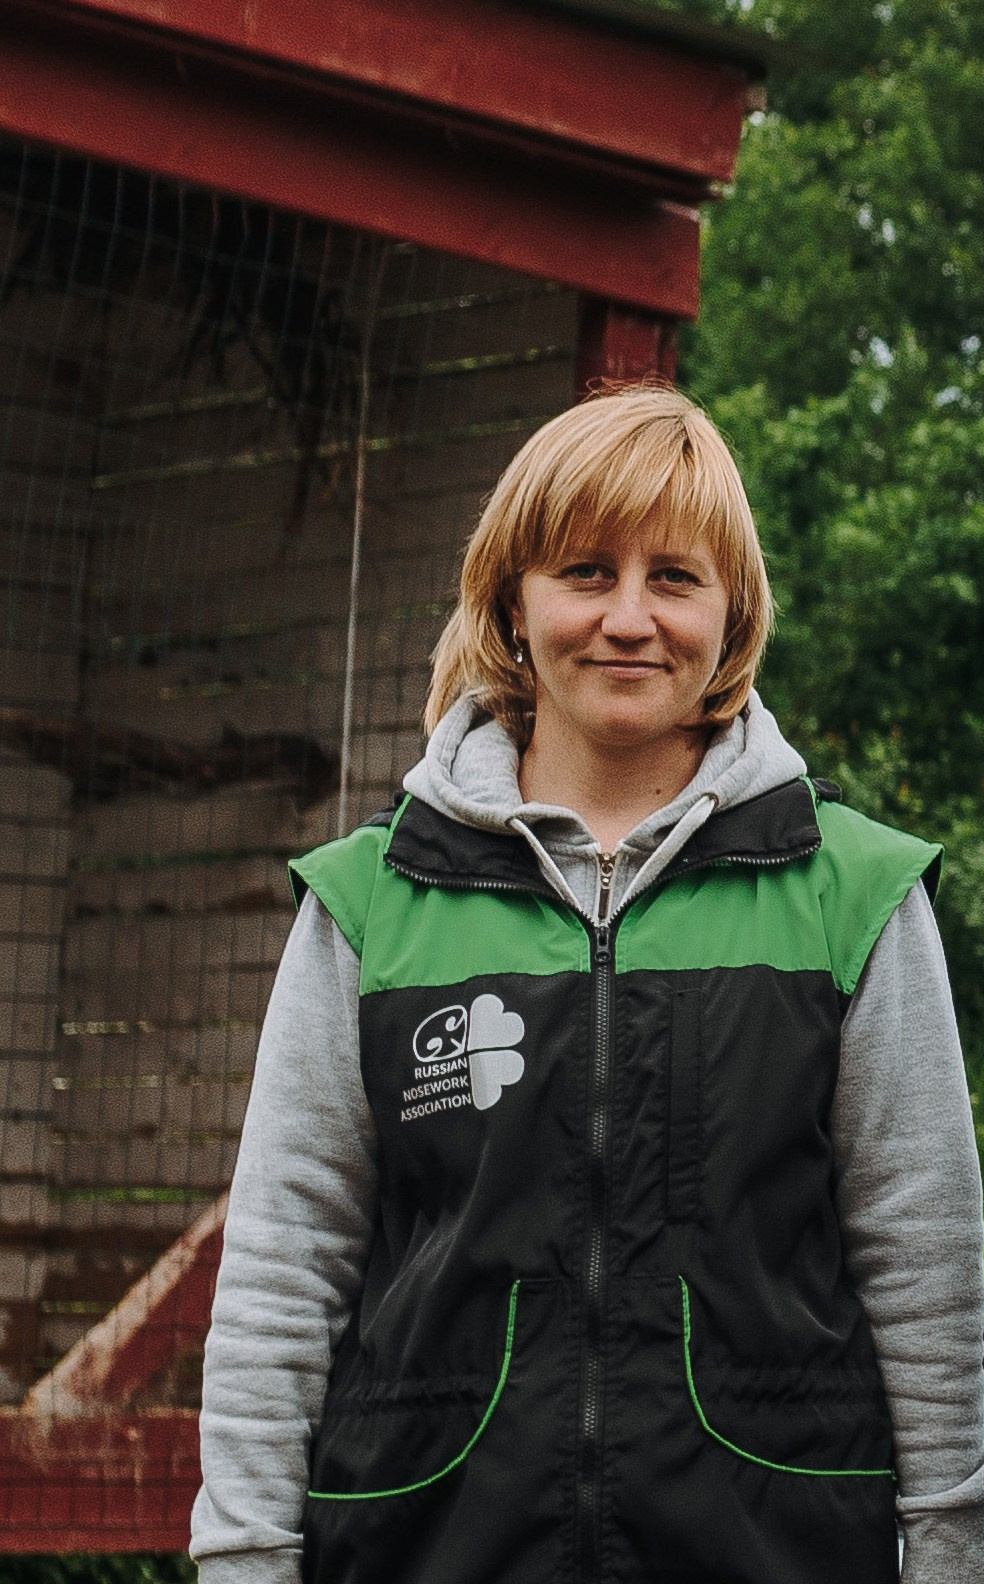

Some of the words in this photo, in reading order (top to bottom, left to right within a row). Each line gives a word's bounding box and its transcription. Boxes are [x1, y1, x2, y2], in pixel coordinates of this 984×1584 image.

[414, 1056, 468, 1080] RUSSIAN
[402, 1075, 469, 1102] NOSEWORK
[400, 1093, 472, 1122] ASSOCIATION
